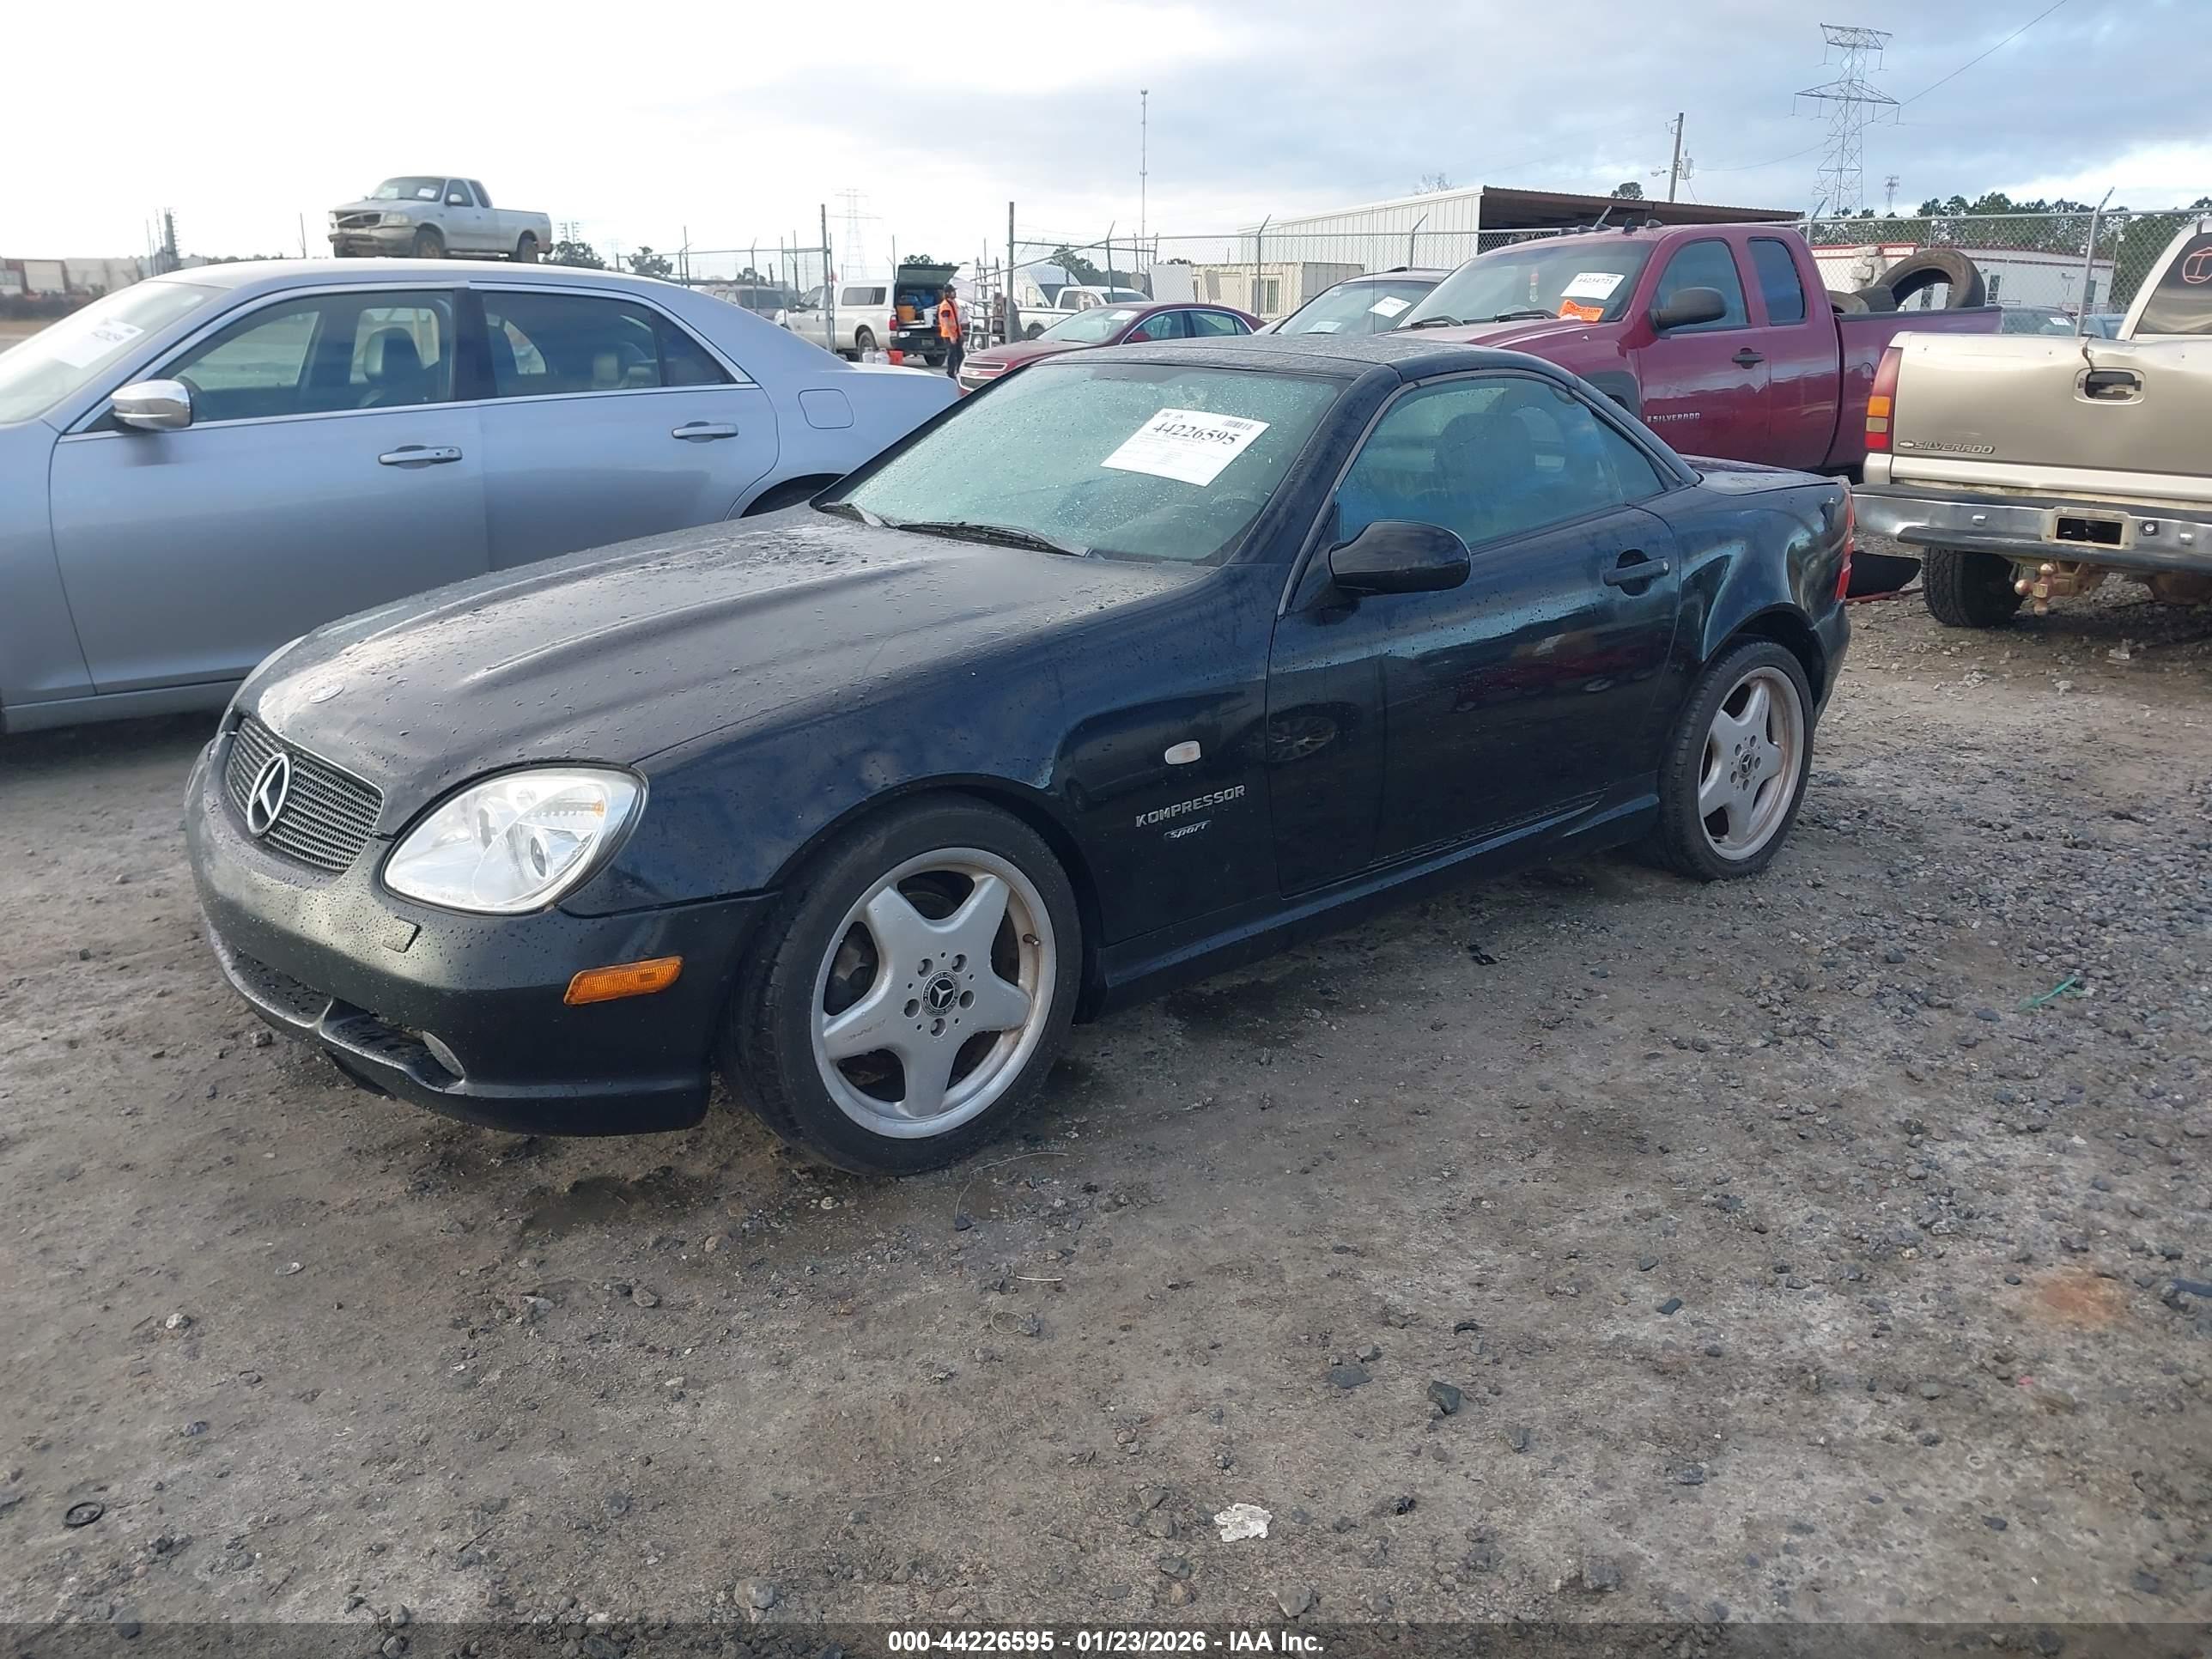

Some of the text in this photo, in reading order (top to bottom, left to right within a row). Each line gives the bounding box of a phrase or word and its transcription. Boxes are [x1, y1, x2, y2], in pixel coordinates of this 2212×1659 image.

[1653, 412, 1701, 422] SILVERADO
[1153, 422, 1242, 446] 44226595
[1913, 441, 1996, 454] SILVERADO
[1135, 784, 1246, 828] KOMPRESSOR
